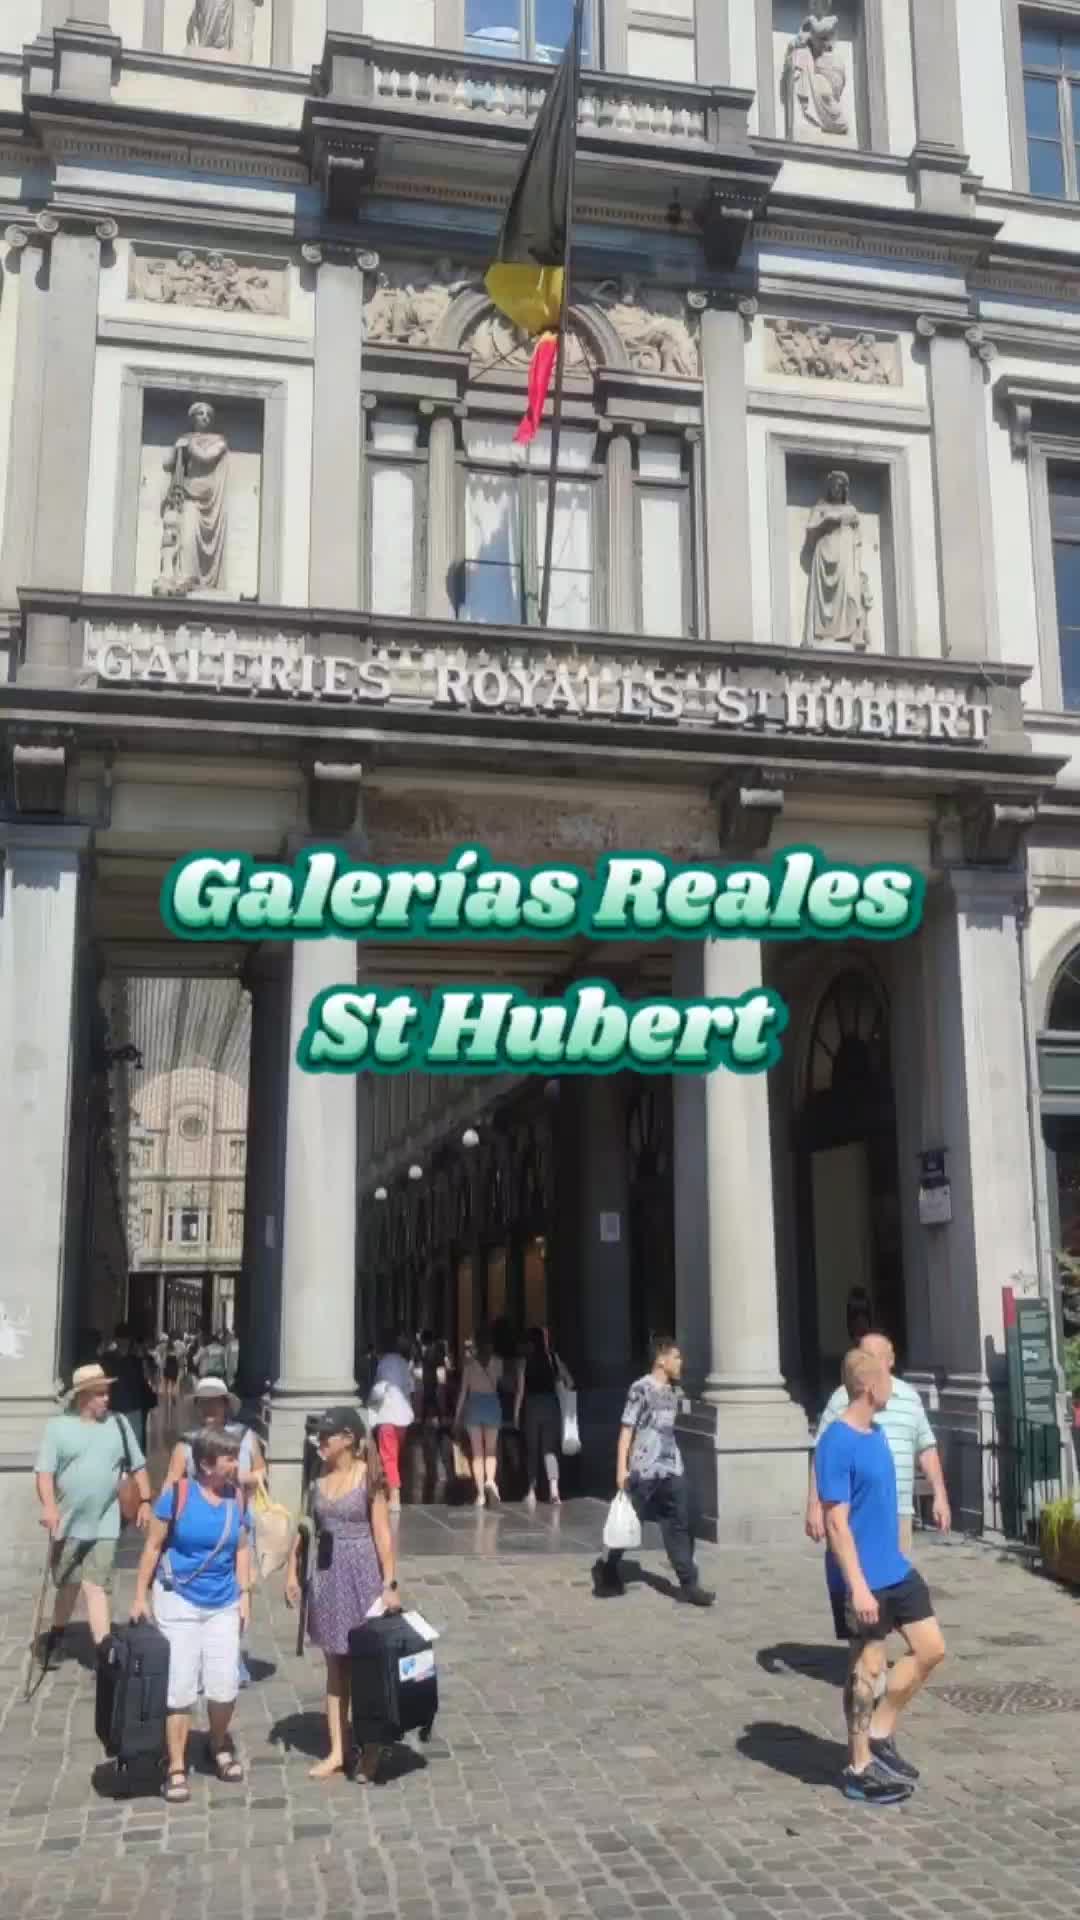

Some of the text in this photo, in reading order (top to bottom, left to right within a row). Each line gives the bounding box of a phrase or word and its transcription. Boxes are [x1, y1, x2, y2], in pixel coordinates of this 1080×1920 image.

[98, 642, 392, 700] GALERIES
[432, 664, 684, 720] ROYALES
[784, 685, 992, 742] HUBERT
